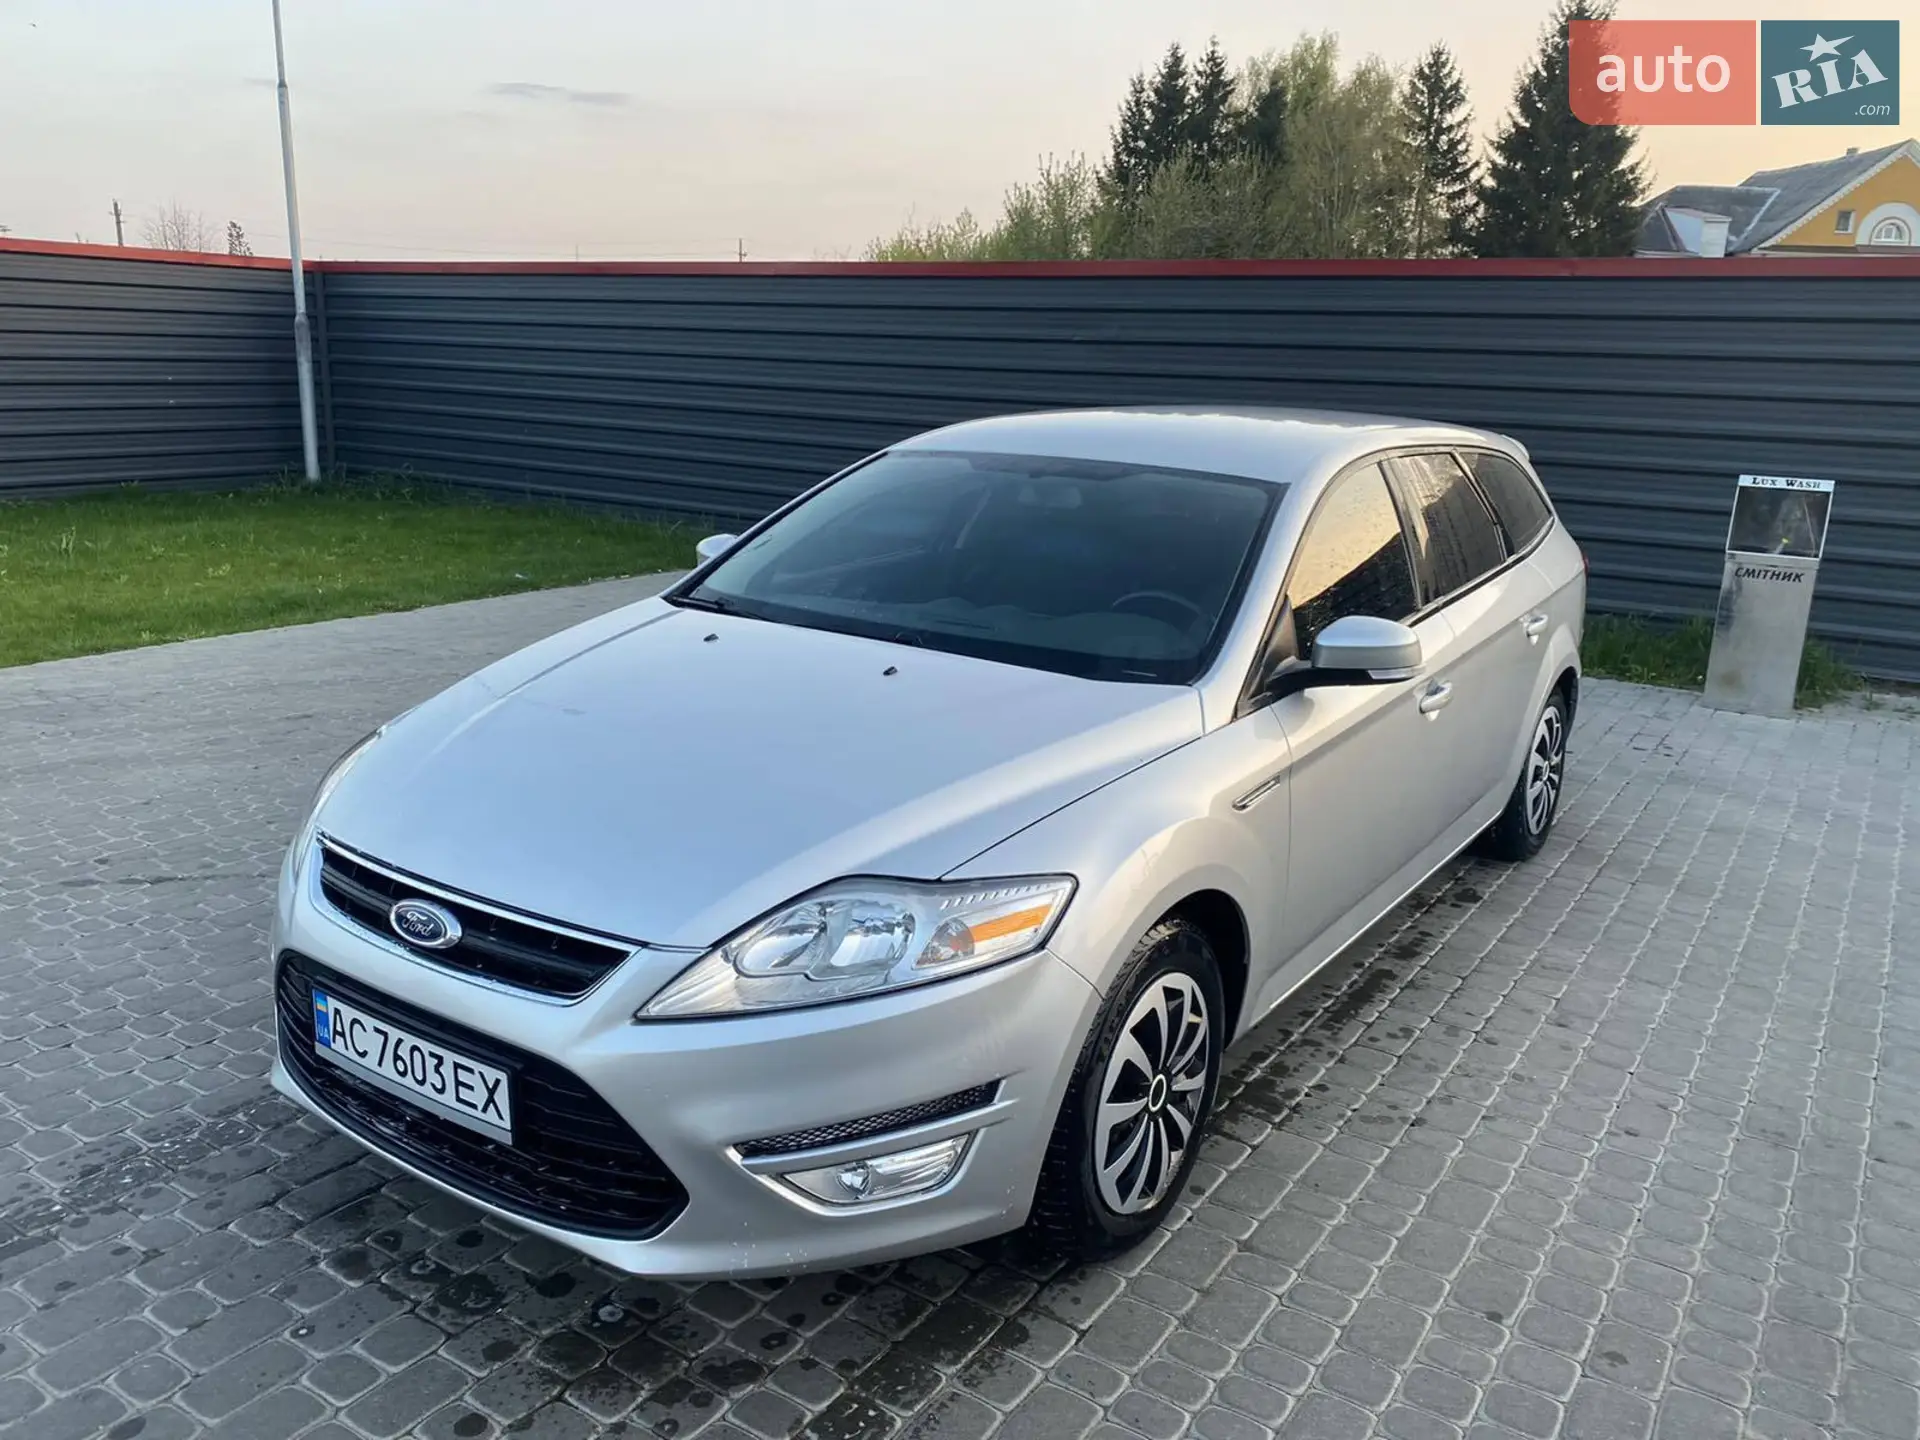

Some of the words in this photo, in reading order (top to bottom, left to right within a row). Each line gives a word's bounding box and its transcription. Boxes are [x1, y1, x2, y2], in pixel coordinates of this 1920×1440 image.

[1734, 567, 1805, 583] СМІТНИК
[401, 911, 433, 937] Ford
[317, 1023, 330, 1039] UA
